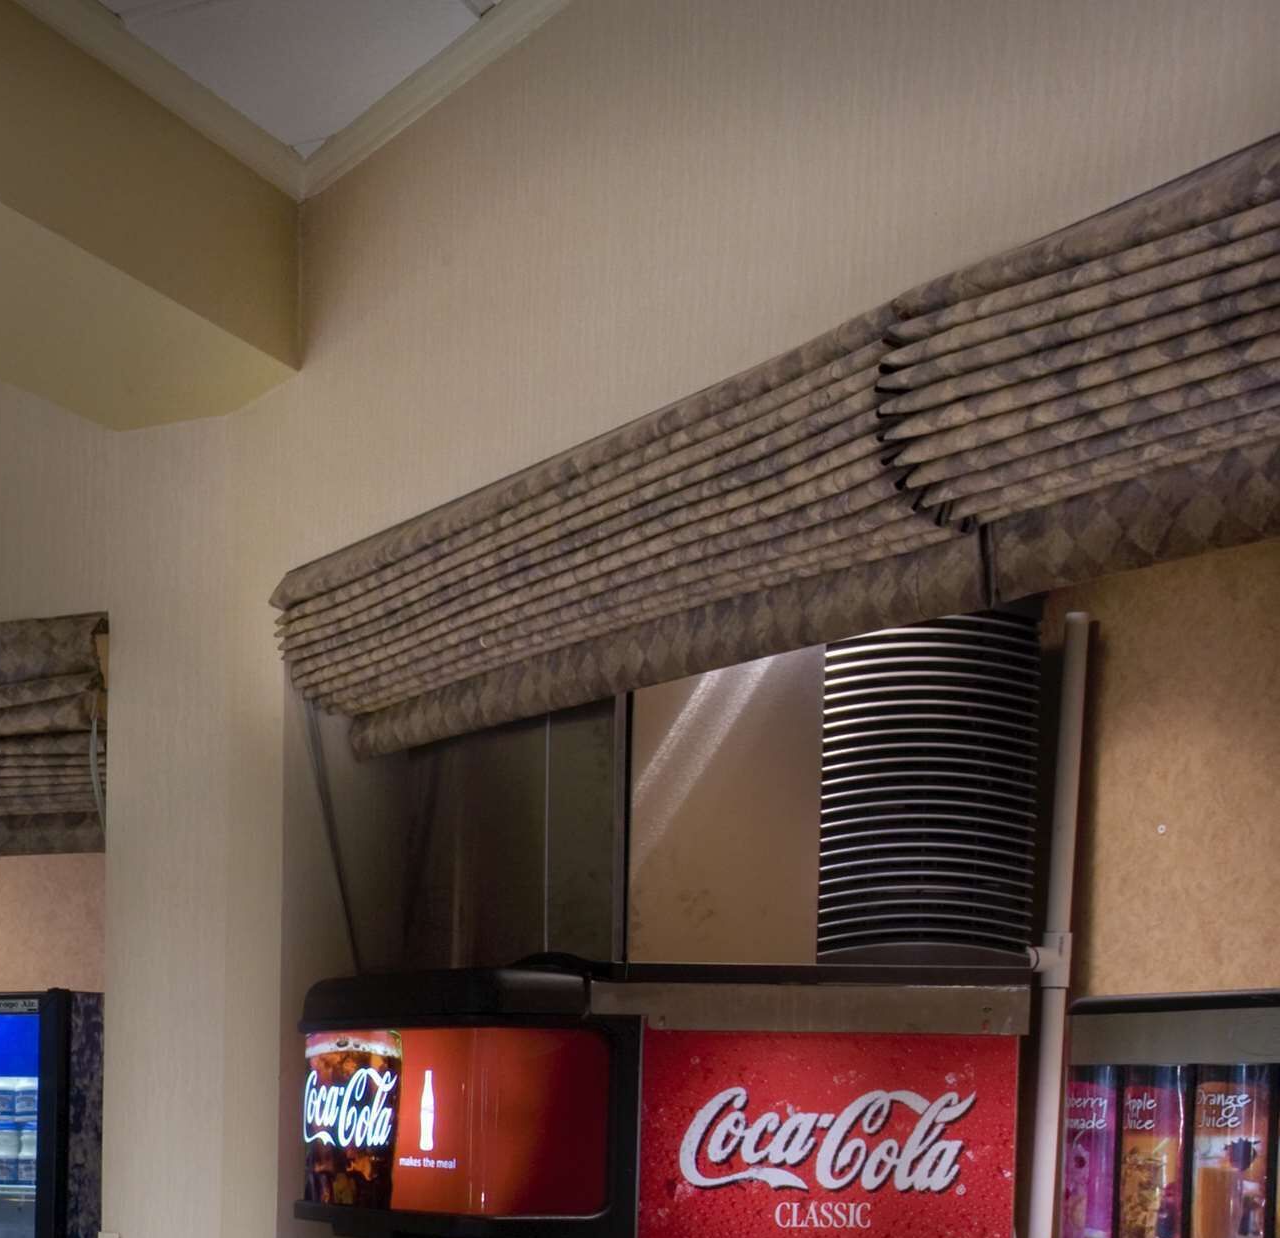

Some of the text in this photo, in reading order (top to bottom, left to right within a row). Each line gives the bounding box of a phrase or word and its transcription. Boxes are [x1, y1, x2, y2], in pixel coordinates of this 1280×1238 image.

[303, 1067, 398, 1148] Coca-Cola
[1197, 1089, 1252, 1118] Orange
[679, 1086, 977, 1193] Coca-Cola
[399, 1156, 456, 1169] makes the meal
[774, 1201, 872, 1228] CLASSIC
